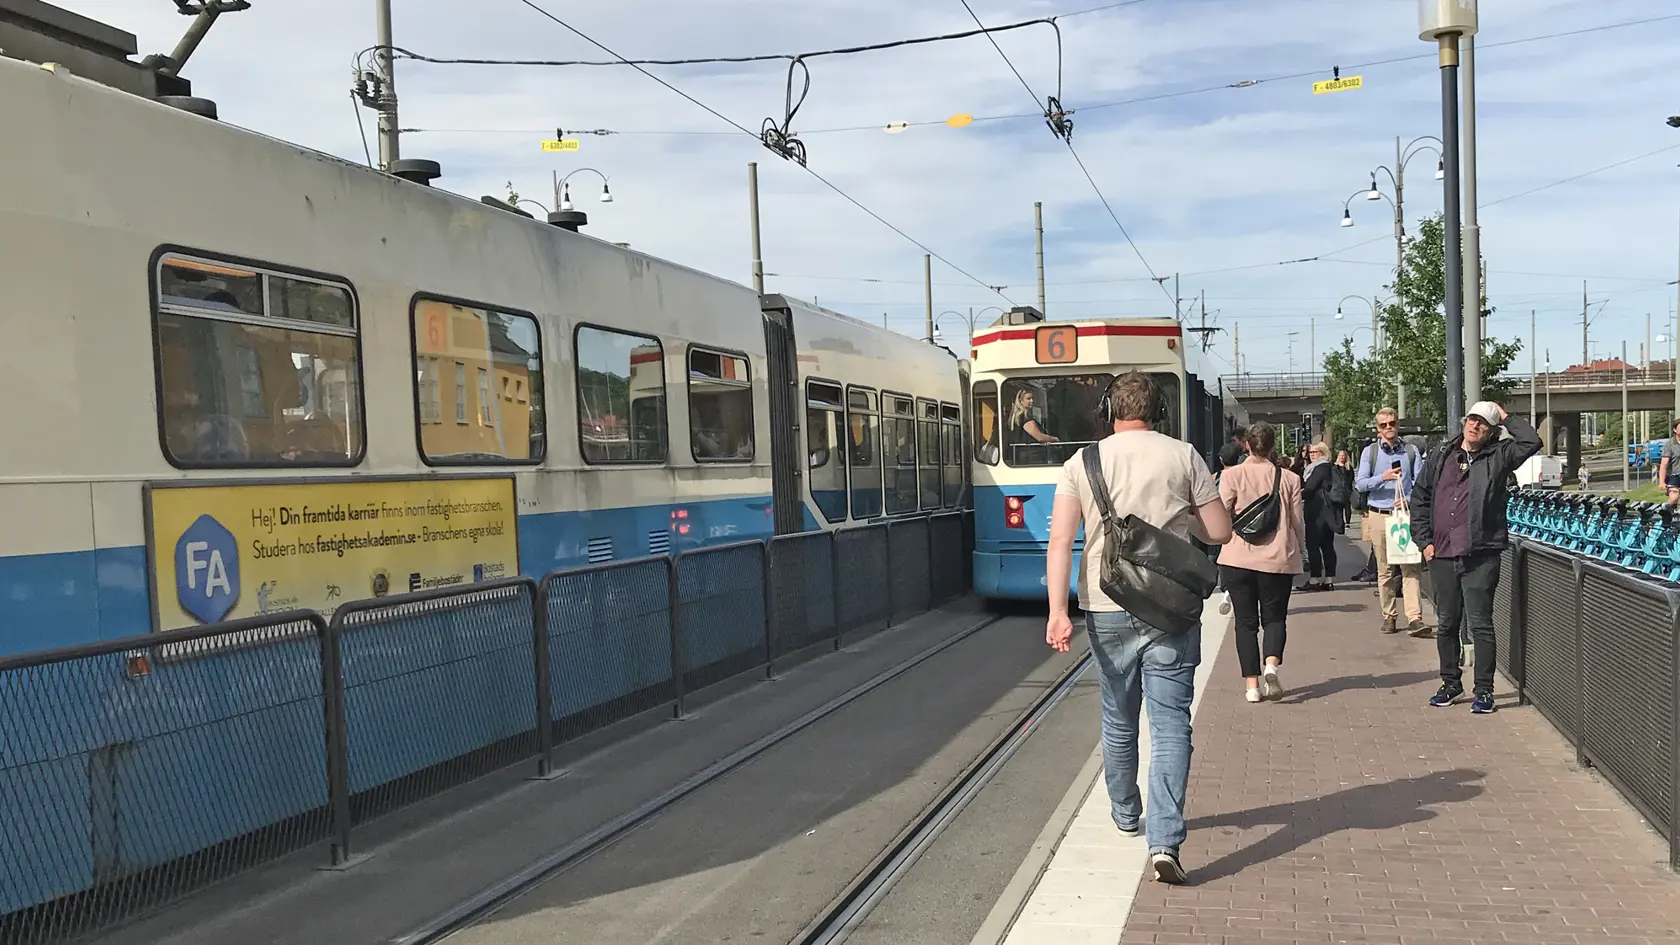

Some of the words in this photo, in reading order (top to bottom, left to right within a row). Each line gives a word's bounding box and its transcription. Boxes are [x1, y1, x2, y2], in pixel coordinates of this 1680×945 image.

[1048, 331, 1065, 360] 6
[251, 507, 277, 534] Hej!
[280, 507, 300, 526] Din
[303, 504, 346, 524] framtida
[347, 503, 380, 521] karriär
[381, 502, 403, 518] finns
[404, 501, 426, 517] inom
[427, 496, 503, 520] fastighetsbranschen.
[252, 538, 296, 560] Studera
[298, 537, 316, 555] hos
[316, 526, 416, 558] fastighetsakademin.se
[422, 524, 468, 542] Branschens
[468, 525, 485, 543] egna
[485, 520, 504, 536] skola!
[186, 541, 231, 598] FA
